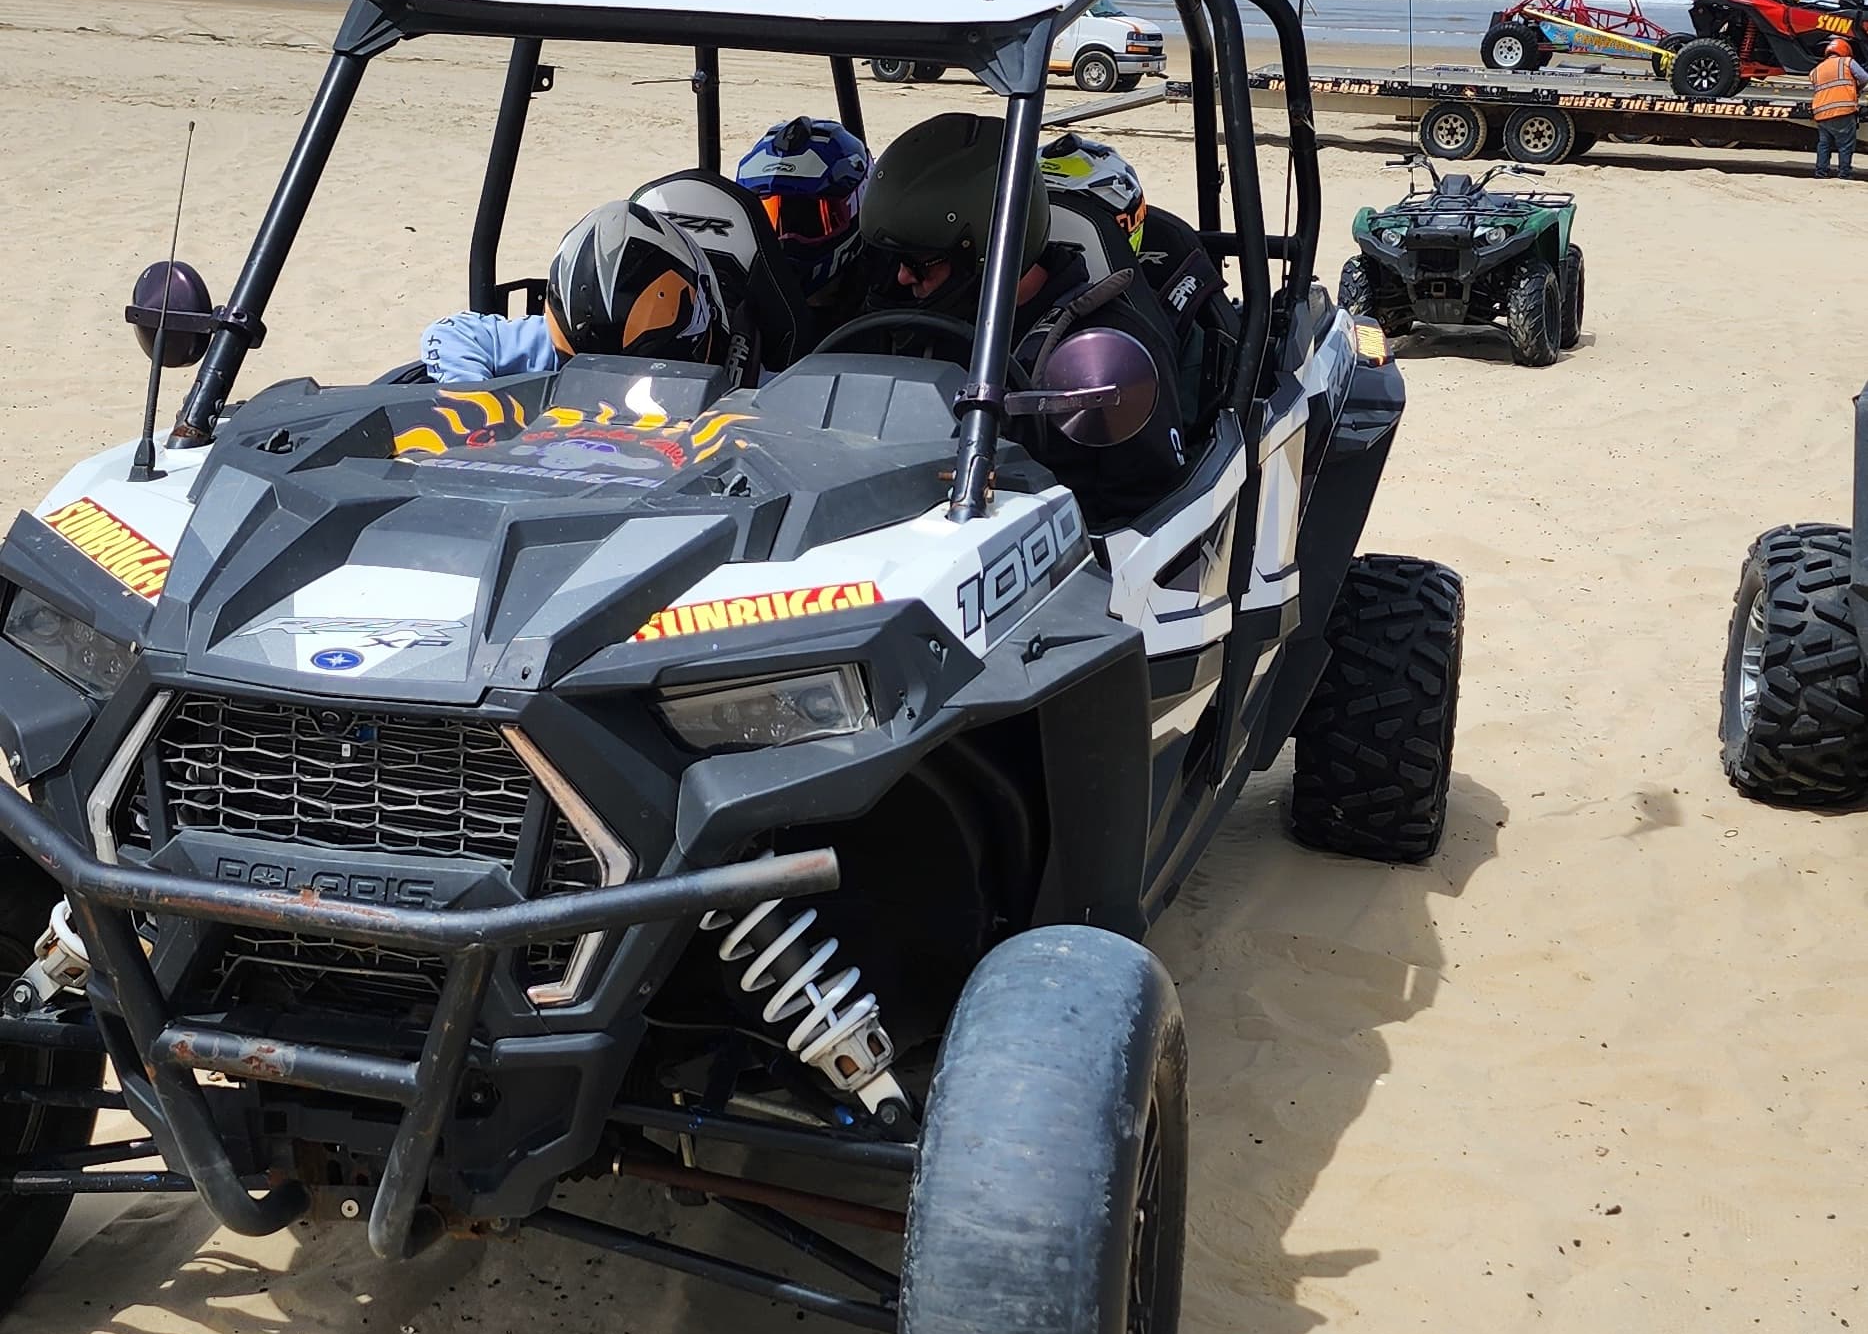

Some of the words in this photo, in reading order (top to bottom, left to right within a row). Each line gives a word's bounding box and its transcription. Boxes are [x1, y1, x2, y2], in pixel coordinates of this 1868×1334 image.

[1815, 14, 1854, 34] SUN
[1558, 95, 1616, 109] WHERE
[1621, 97, 1650, 111] THE
[1654, 99, 1687, 113] FUN
[1692, 102, 1748, 116] NEVER
[1752, 105, 1792, 118] SETS
[42, 500, 171, 596] SUNBUGGY
[957, 497, 1083, 640] 1000
[233, 616, 468, 638] RZR
[357, 637, 454, 649] XP
